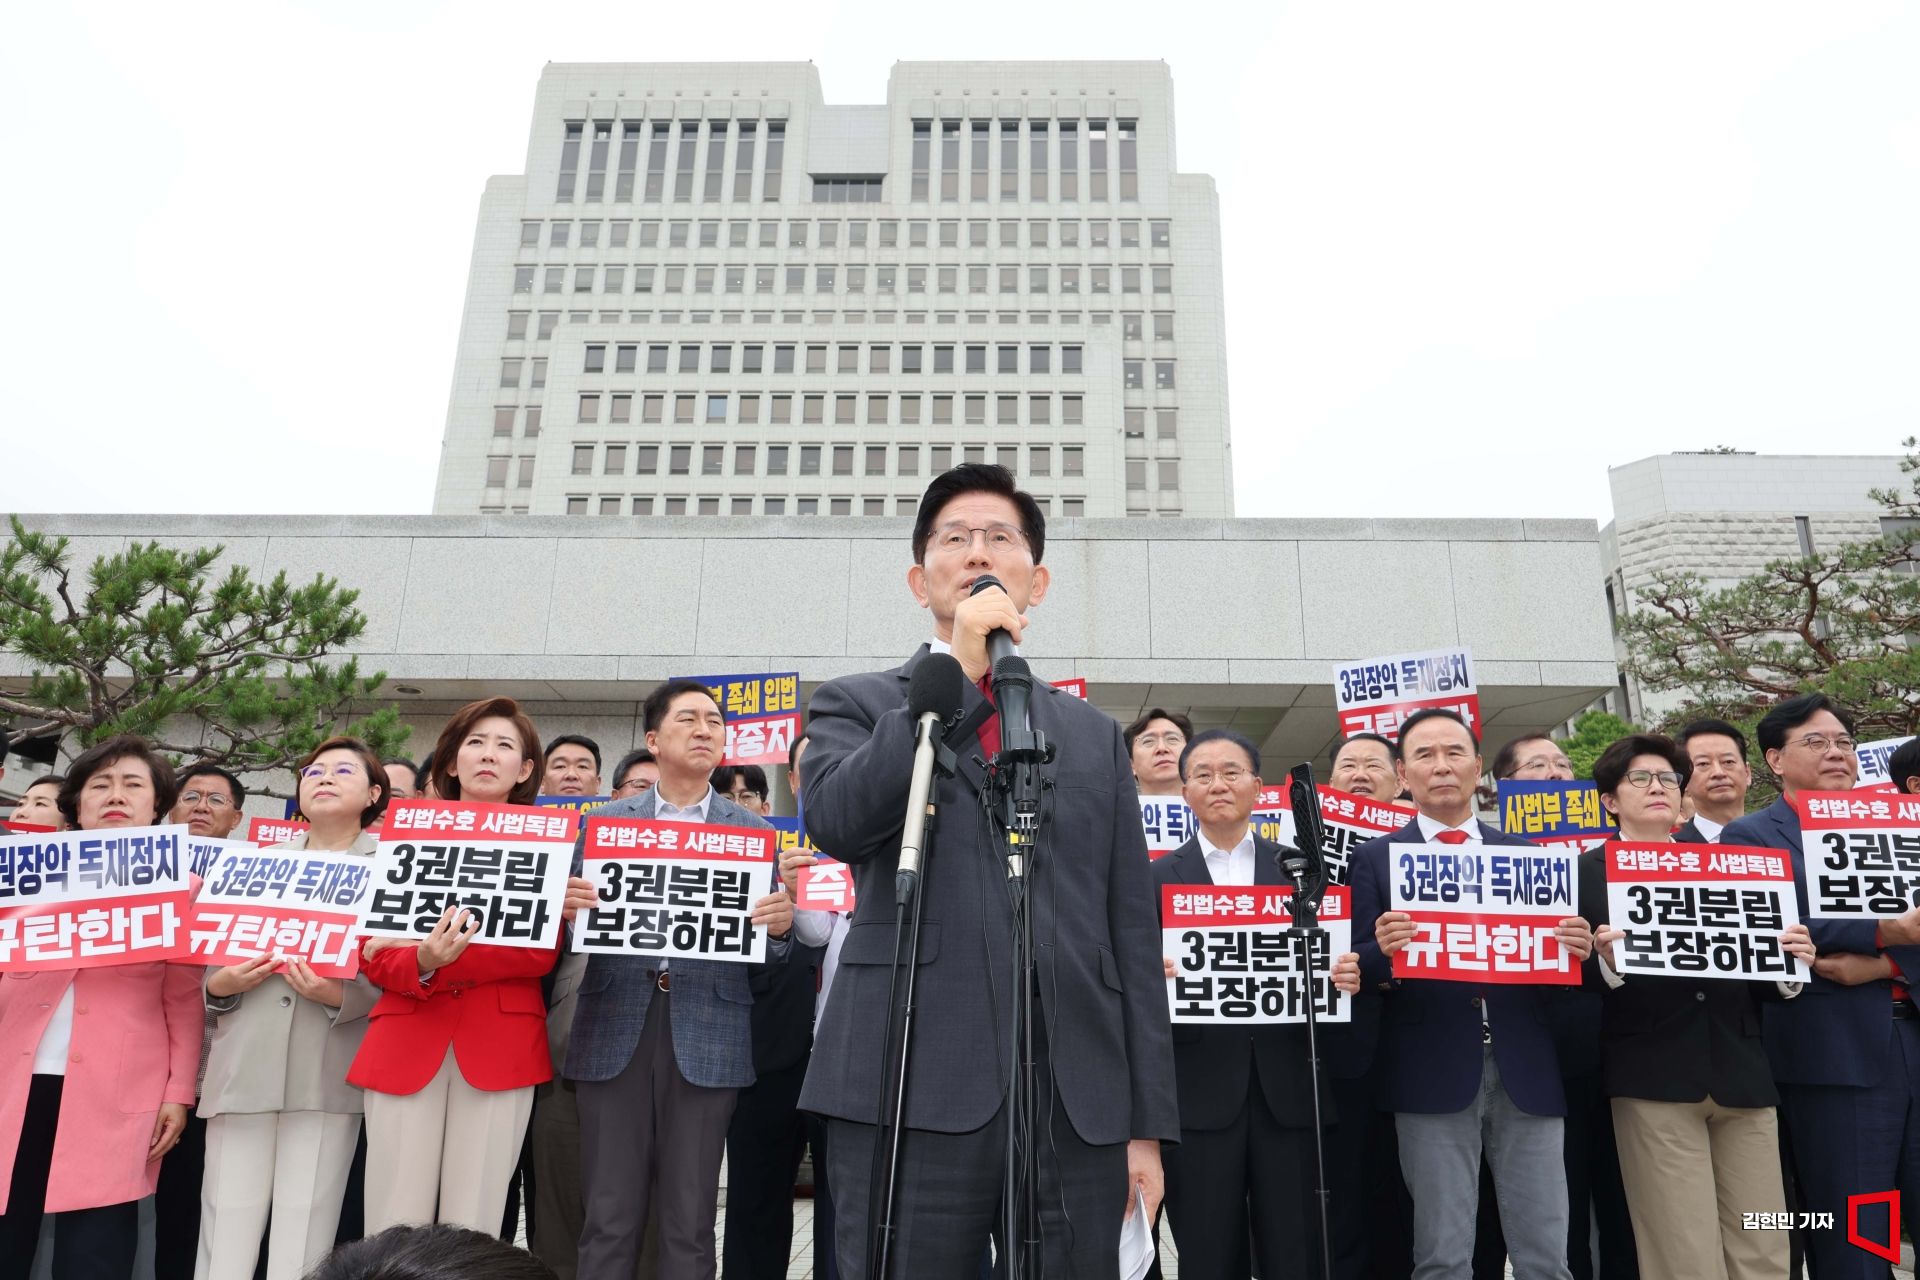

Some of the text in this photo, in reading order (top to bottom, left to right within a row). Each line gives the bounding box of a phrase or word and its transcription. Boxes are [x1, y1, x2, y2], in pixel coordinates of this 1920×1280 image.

[727, 680, 760, 716] 족쇄
[764, 676, 797, 712] 입법
[1340, 653, 1469, 703] 3권장악 독재정치
[1857, 745, 1898, 778] 독재
[393, 808, 569, 838] 헌법수호 사법독립
[1505, 791, 1562, 834] 사법부
[1565, 789, 1601, 829] 족쇄
[1808, 798, 1891, 819] 헌법수호
[78, 834, 179, 889] 독재정치
[596, 826, 679, 850] 헌법수호
[684, 830, 765, 857] 사법독립
[1616, 850, 1785, 877] 헌법수호 사법독립
[211, 856, 299, 899] 3권장악
[386, 843, 549, 893] 3권분립
[598, 862, 751, 911] 3권분립
[1399, 853, 1484, 904] 3권장악
[1490, 855, 1572, 906] 독재정치
[364, 889, 549, 941] 보장하라
[1172, 894, 1255, 916] 헌법수호
[1627, 885, 1783, 930] 3권분립
[1819, 875, 1920, 913] 보장
[190, 912, 359, 967] 규탄한다
[583, 907, 756, 955] 보장하라
[1181, 930, 1331, 972] 3권분립
[1401, 921, 1571, 973] 규탄한다
[1622, 929, 1800, 976] 보장하라
[1175, 976, 1342, 1018] 보장하라
